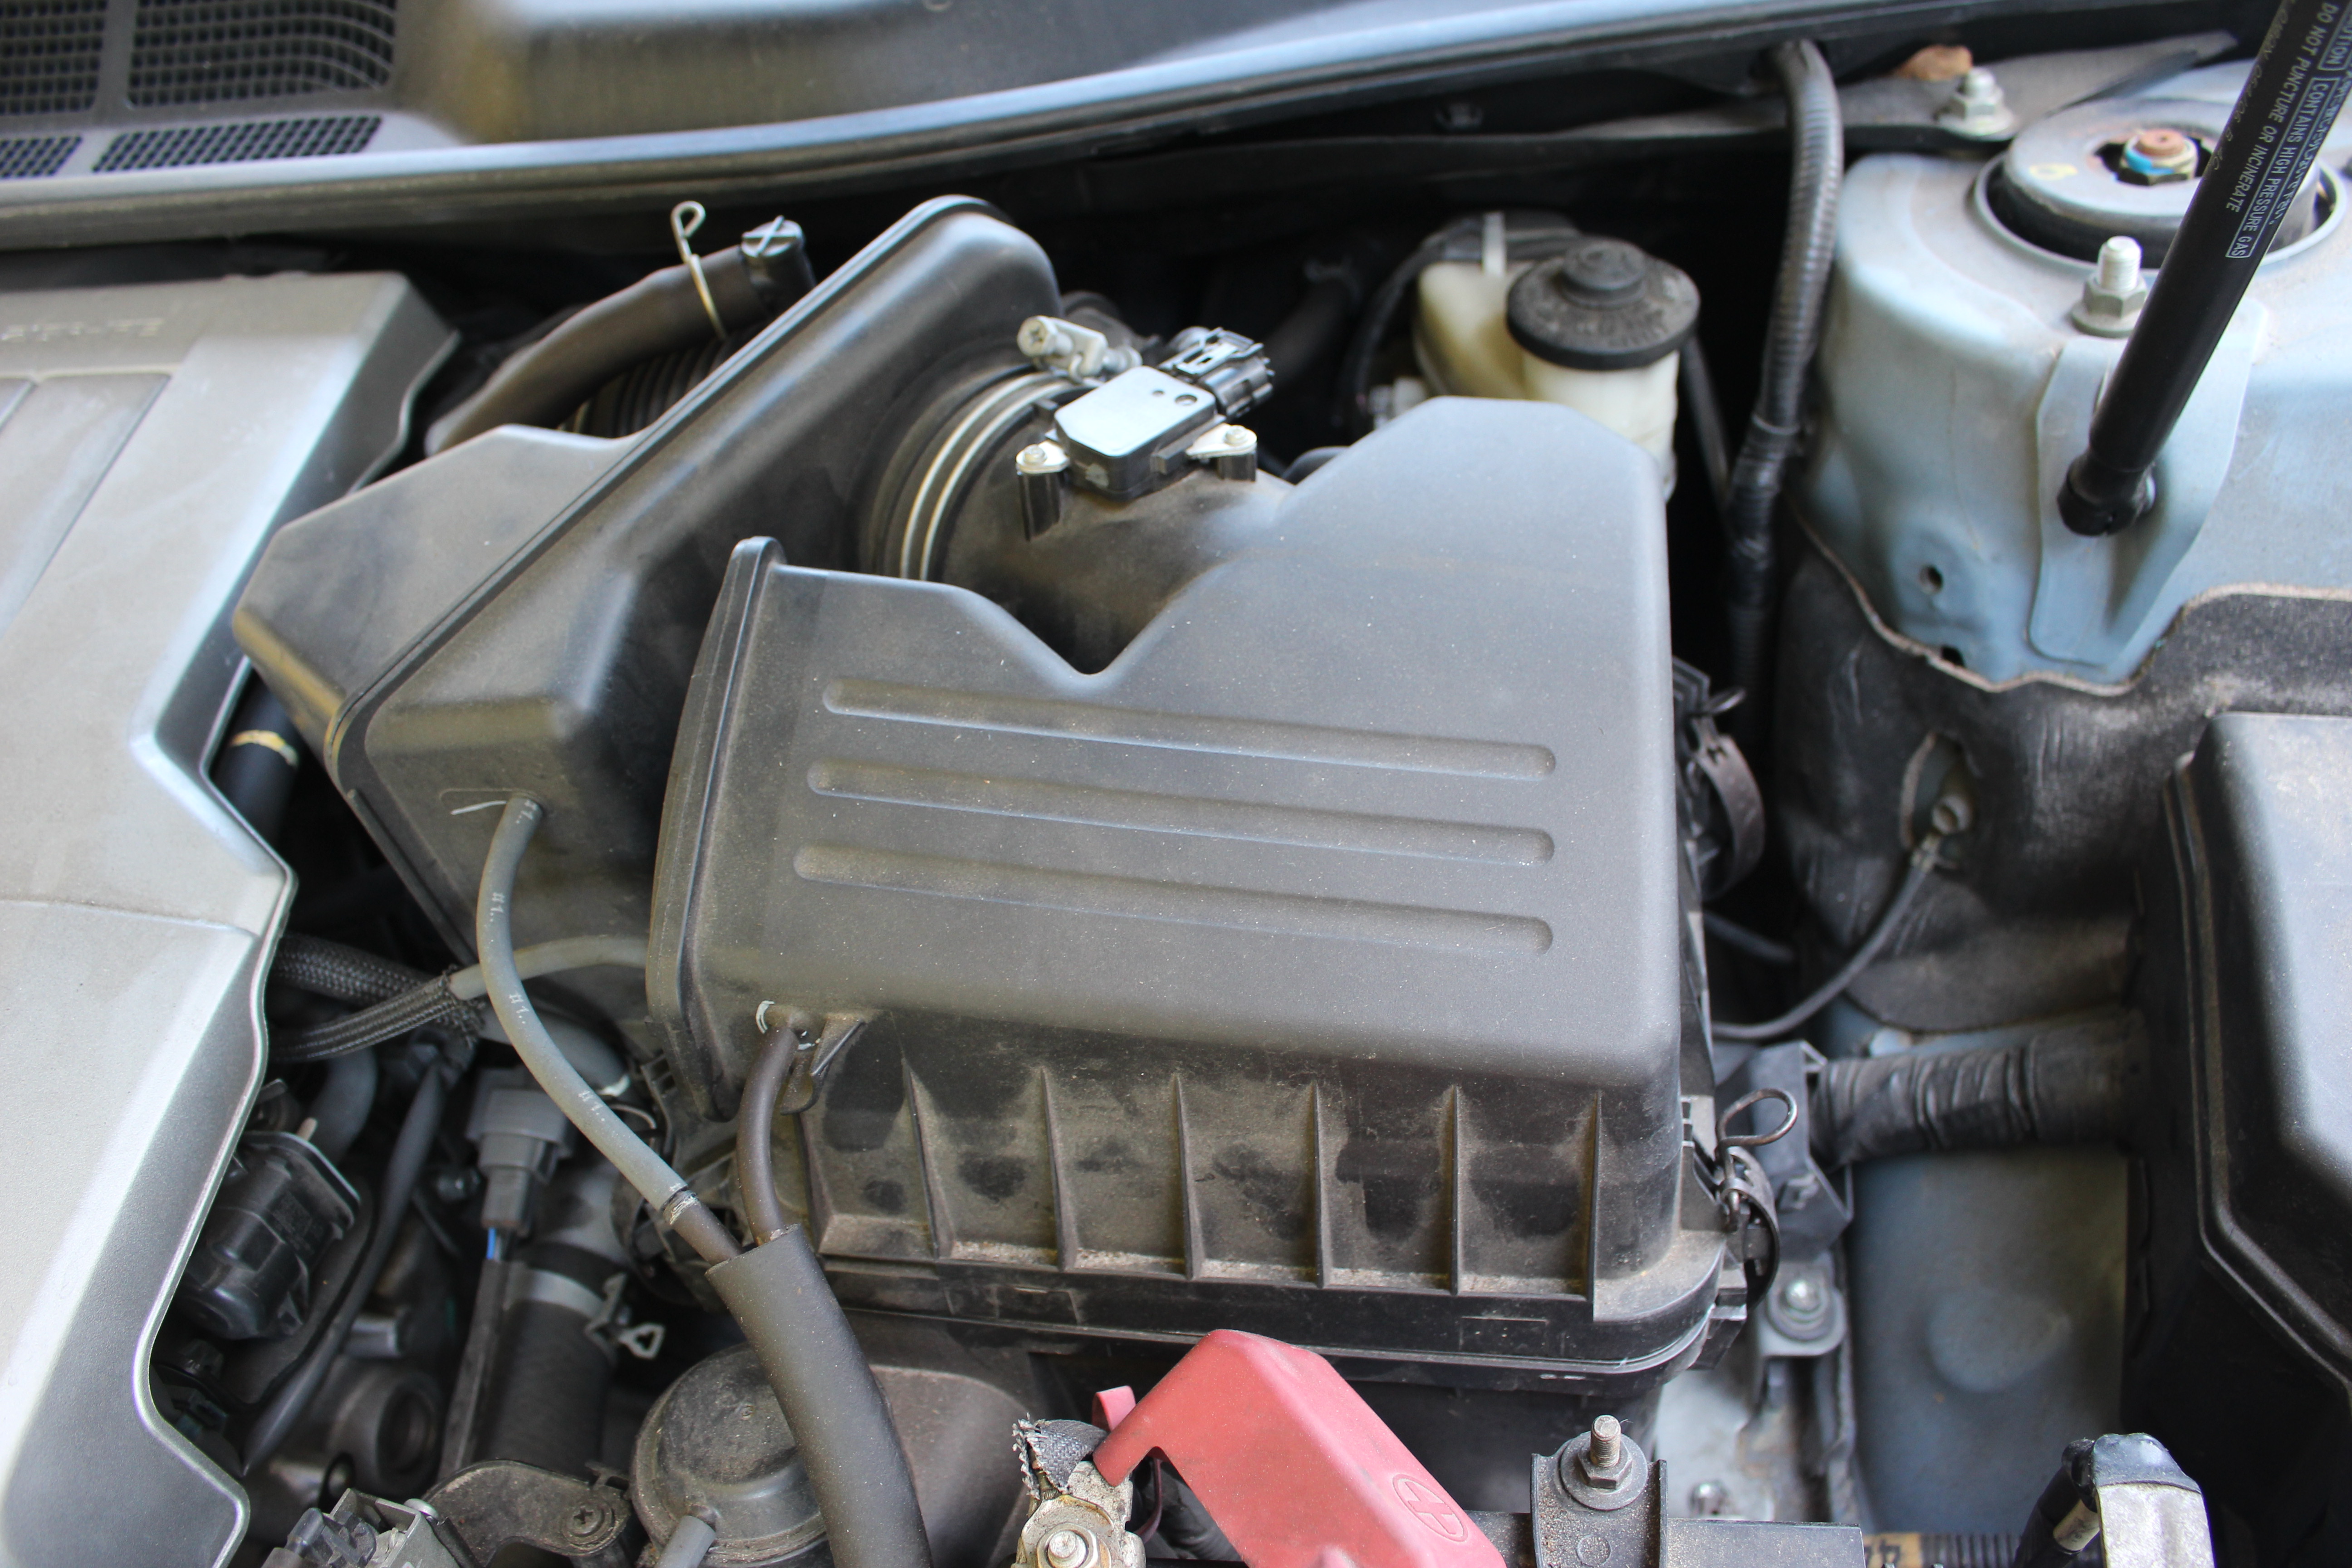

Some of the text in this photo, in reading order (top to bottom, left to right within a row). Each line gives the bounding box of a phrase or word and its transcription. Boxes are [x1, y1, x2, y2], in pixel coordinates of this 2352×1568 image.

[2226, 2, 2339, 212] DO NOT PUNCTURE OR INCINERATE
[2231, 83, 2328, 257] CONTAINS HIGH PRESSURE GAS
